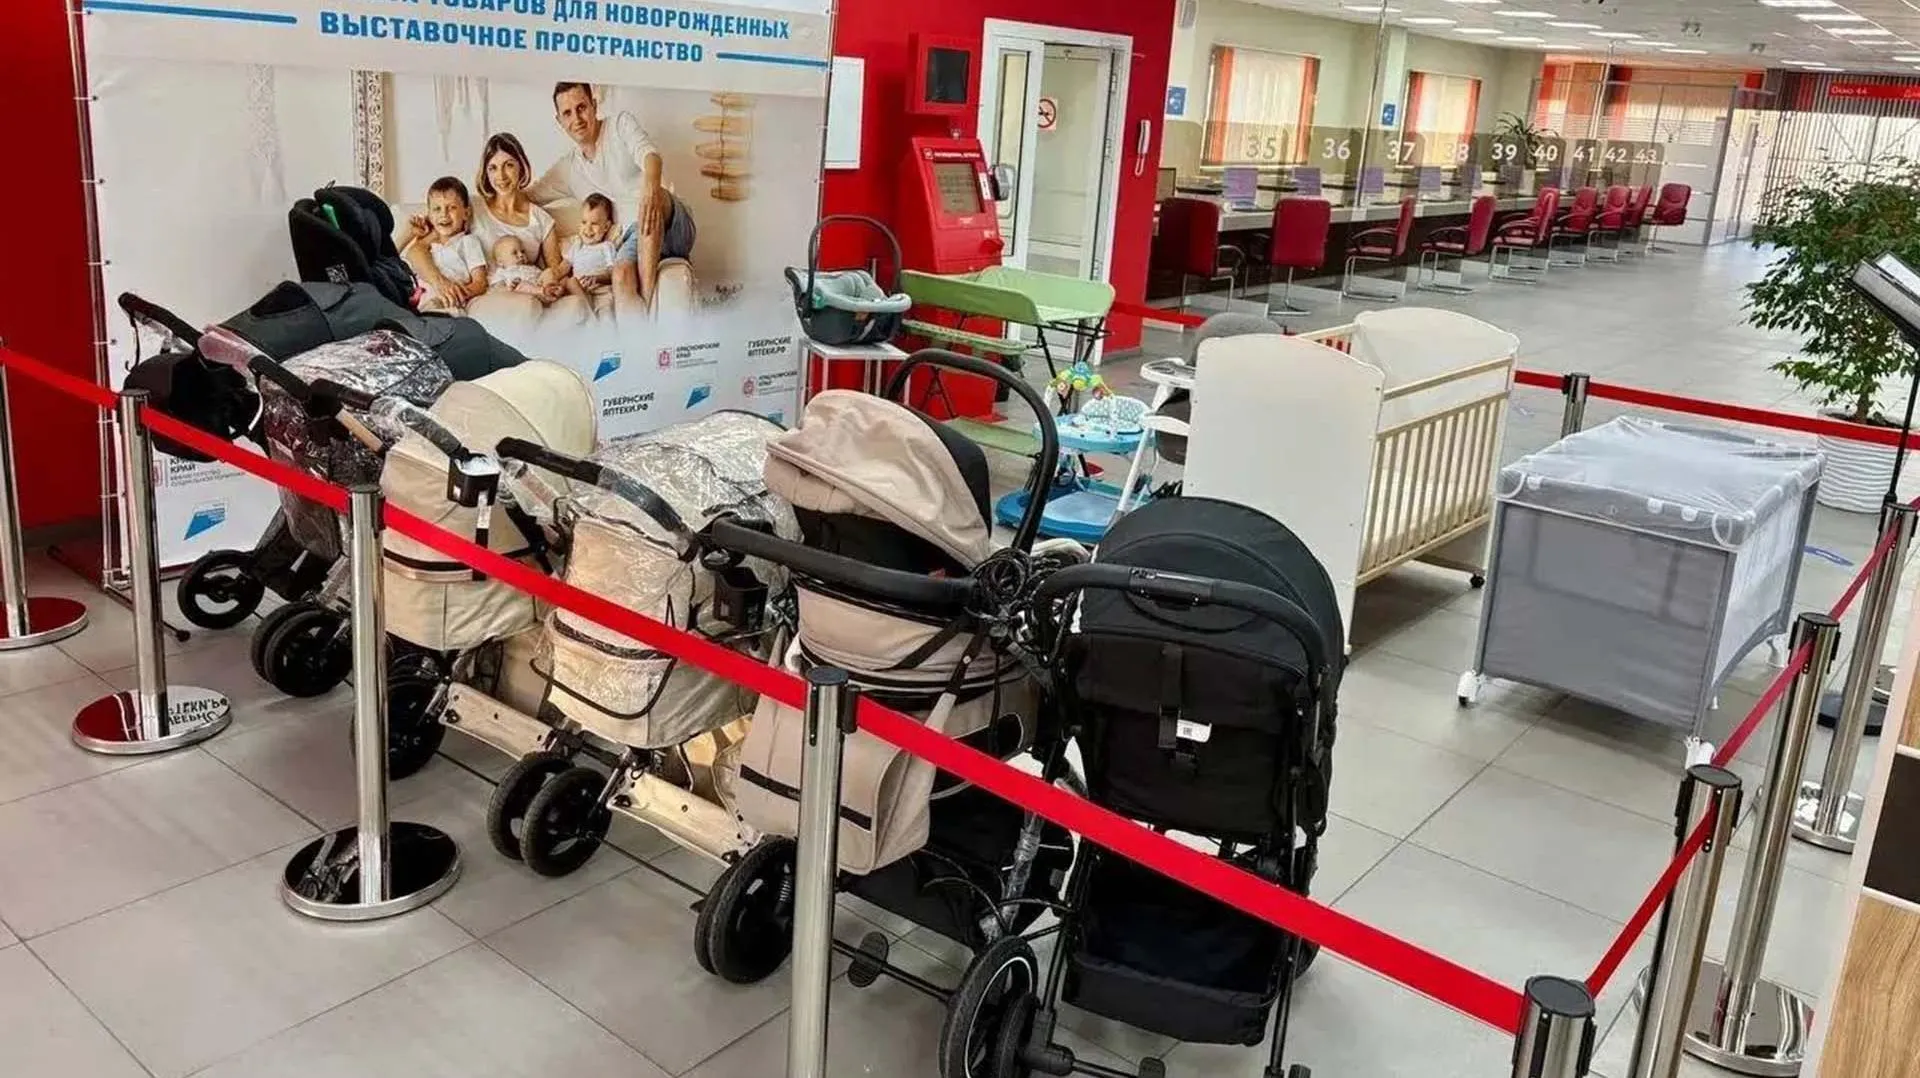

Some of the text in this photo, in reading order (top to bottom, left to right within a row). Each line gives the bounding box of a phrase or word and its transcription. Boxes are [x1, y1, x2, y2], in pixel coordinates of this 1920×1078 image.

[430, 0, 790, 39] АРОВ ДЛЯ НОВОРОЖДЕННЫХ
[320, 11, 703, 62] ВЫСТАВОЧНОЕ ПРОСТРАНСТВО
[1246, 136, 1277, 160] 35
[1321, 137, 1352, 160] 36
[1386, 140, 1416, 161] 37
[1443, 142, 1470, 162] 38
[1491, 142, 1518, 161] 39
[1533, 144, 1559, 162] 40
[1573, 145, 1596, 162] 41
[1605, 147, 1628, 163] 42
[1634, 148, 1658, 164] 43
[748, 336, 792, 348] ГУБЕРНСКИЕ
[603, 392, 655, 407] ГУБЕРНСКИЕ
[603, 403, 649, 417] АПТЕКИ.РФ
